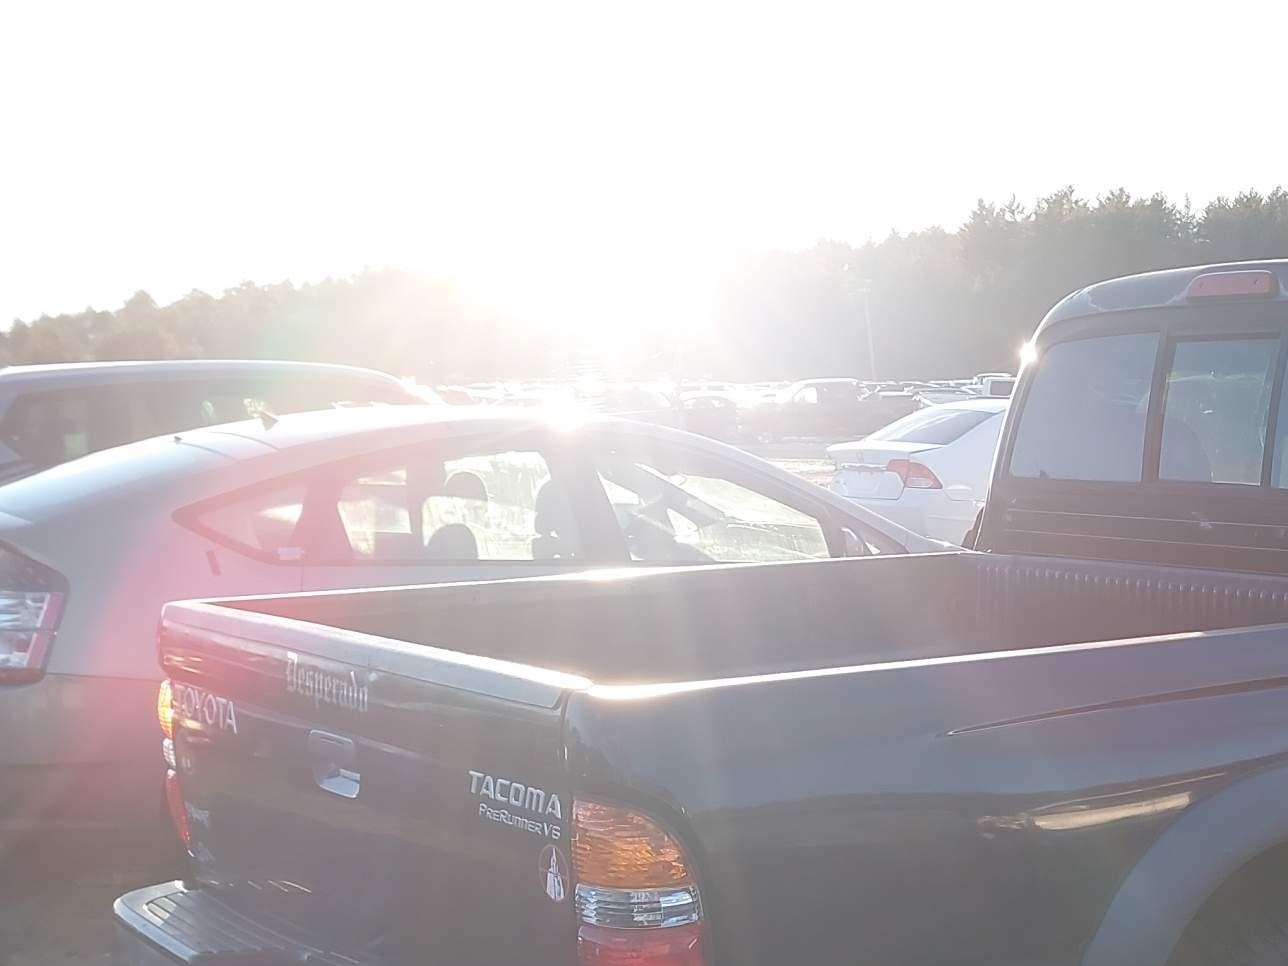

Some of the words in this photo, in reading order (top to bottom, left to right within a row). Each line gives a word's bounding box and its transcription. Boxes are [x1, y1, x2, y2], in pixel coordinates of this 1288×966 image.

[286, 651, 369, 713] Desperado
[174, 683, 238, 735] TOYOTA
[468, 769, 562, 820] TACOMA
[543, 822, 561, 840] V6
